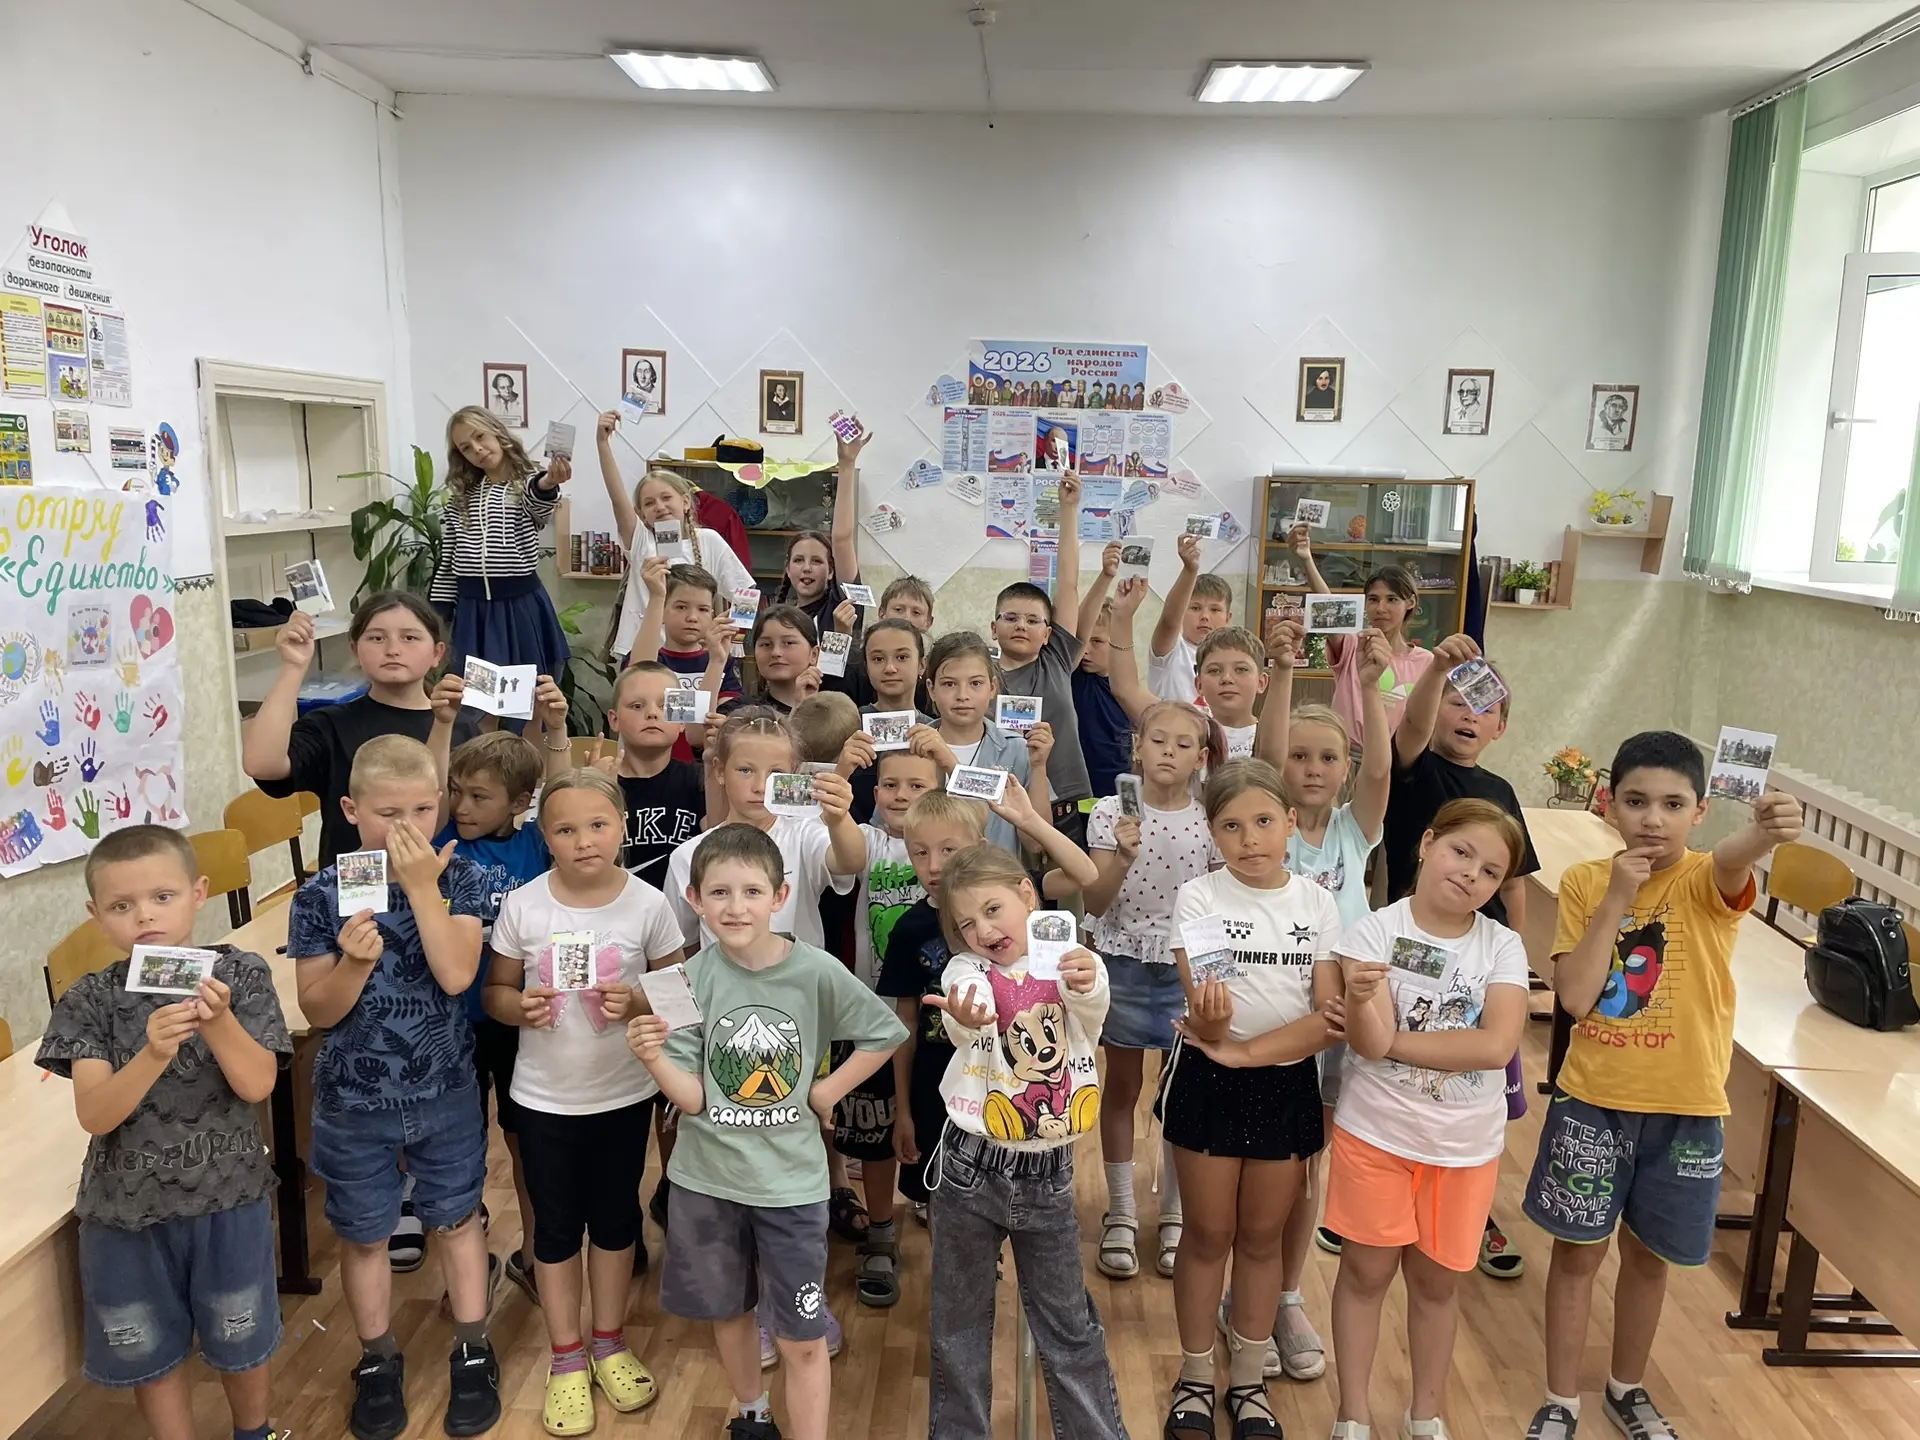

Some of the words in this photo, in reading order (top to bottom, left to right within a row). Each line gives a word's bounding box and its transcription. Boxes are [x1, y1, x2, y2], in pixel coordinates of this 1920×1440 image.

[31, 225, 88, 259] Уголок
[28, 255, 92, 280] безопасности
[7, 271, 60, 294] дорожного
[68, 284, 112, 304] движения
[984, 350, 1051, 372] 2026
[1052, 346, 1073, 356] Год
[1076, 348, 1139, 358] единства
[1067, 358, 1123, 368] народов
[1071, 367, 1118, 377] России
[1035, 479, 1061, 487] РОСС
[16, 493, 124, 564] отряд
[620, 807, 697, 848] KE
[1281, 952, 1313, 966] VIBES
[1538, 1190, 1607, 1226] STYLE
